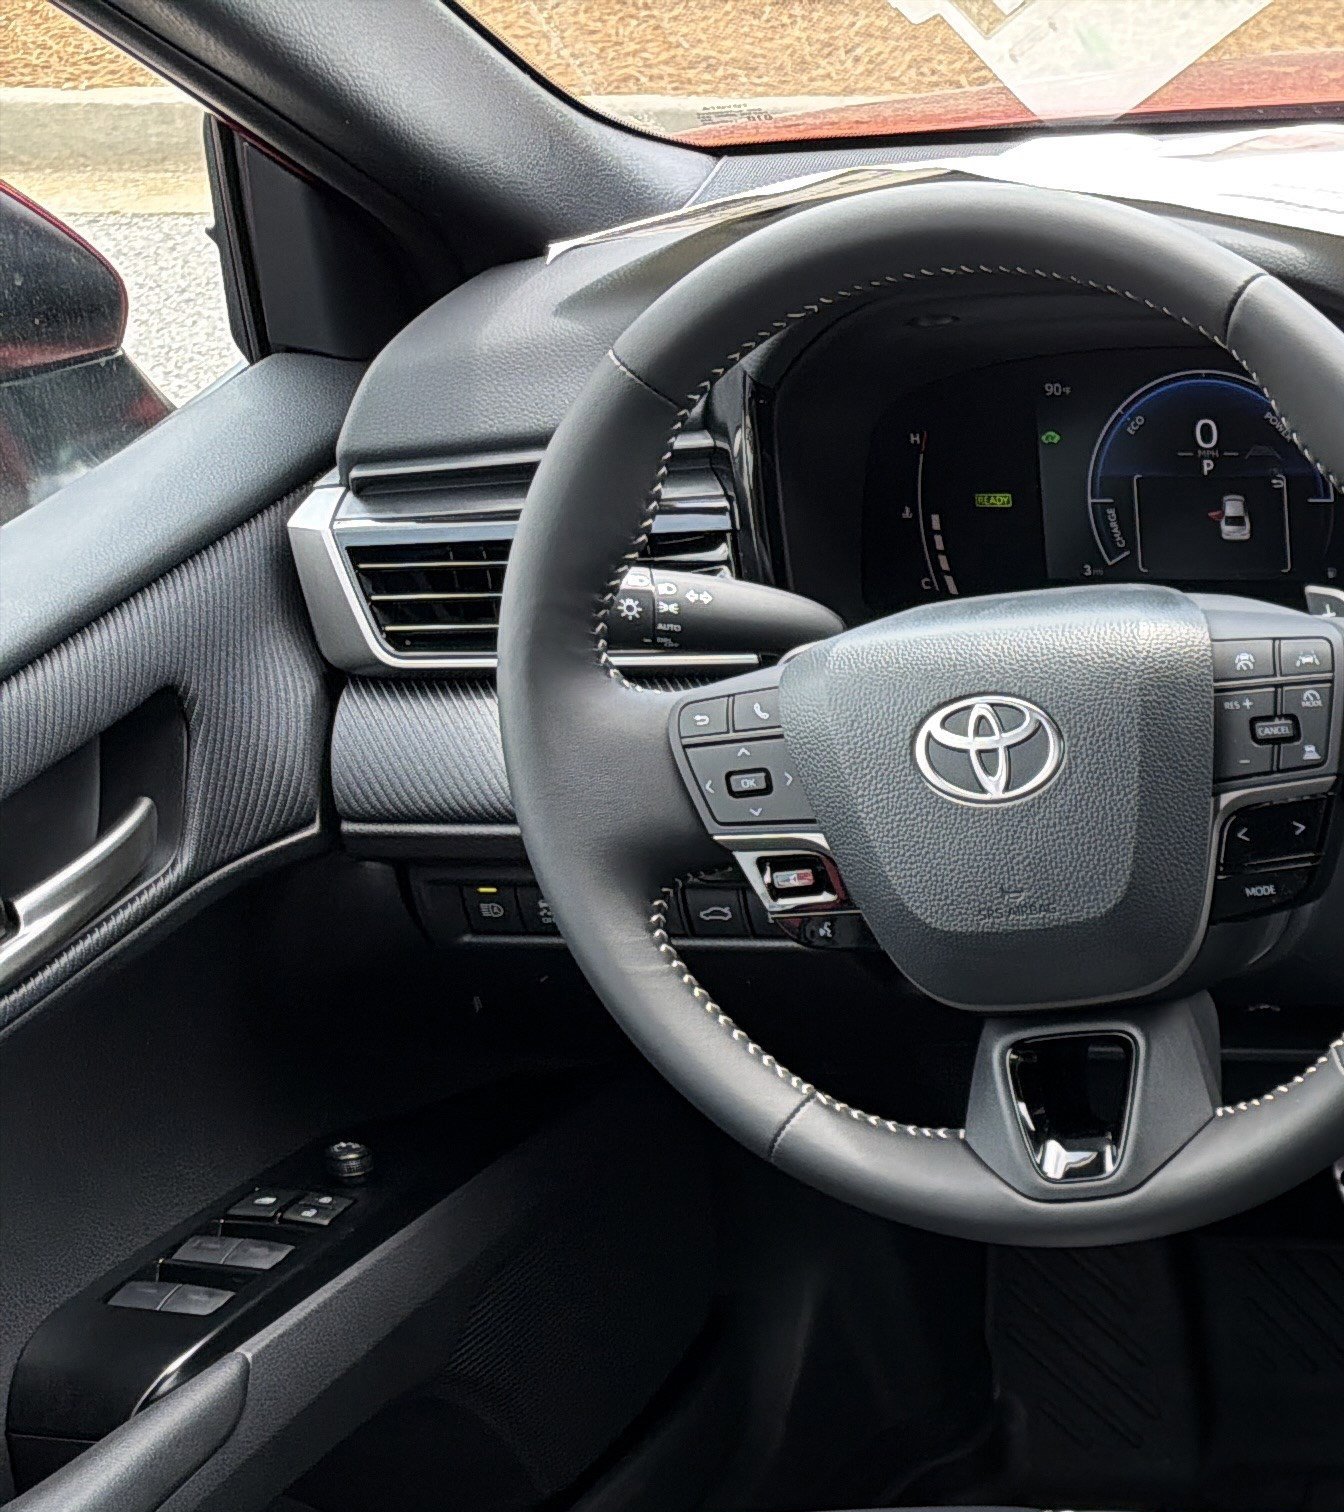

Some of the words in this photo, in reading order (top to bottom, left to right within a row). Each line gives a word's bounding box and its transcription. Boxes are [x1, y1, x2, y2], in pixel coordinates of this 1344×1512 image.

[1126, 415, 1145, 436] ECO
[910, 433, 920, 444] H
[1195, 418, 1218, 449] 0
[1202, 460, 1215, 476] P
[977, 495, 1010, 505] READY
[1106, 507, 1126, 548] CHARGE
[656, 623, 682, 632] AUTO
[1224, 700, 1240, 710] RES
[1257, 726, 1290, 736] CANCEL
[741, 778, 756, 788] OK
[1245, 884, 1276, 897] MODE
